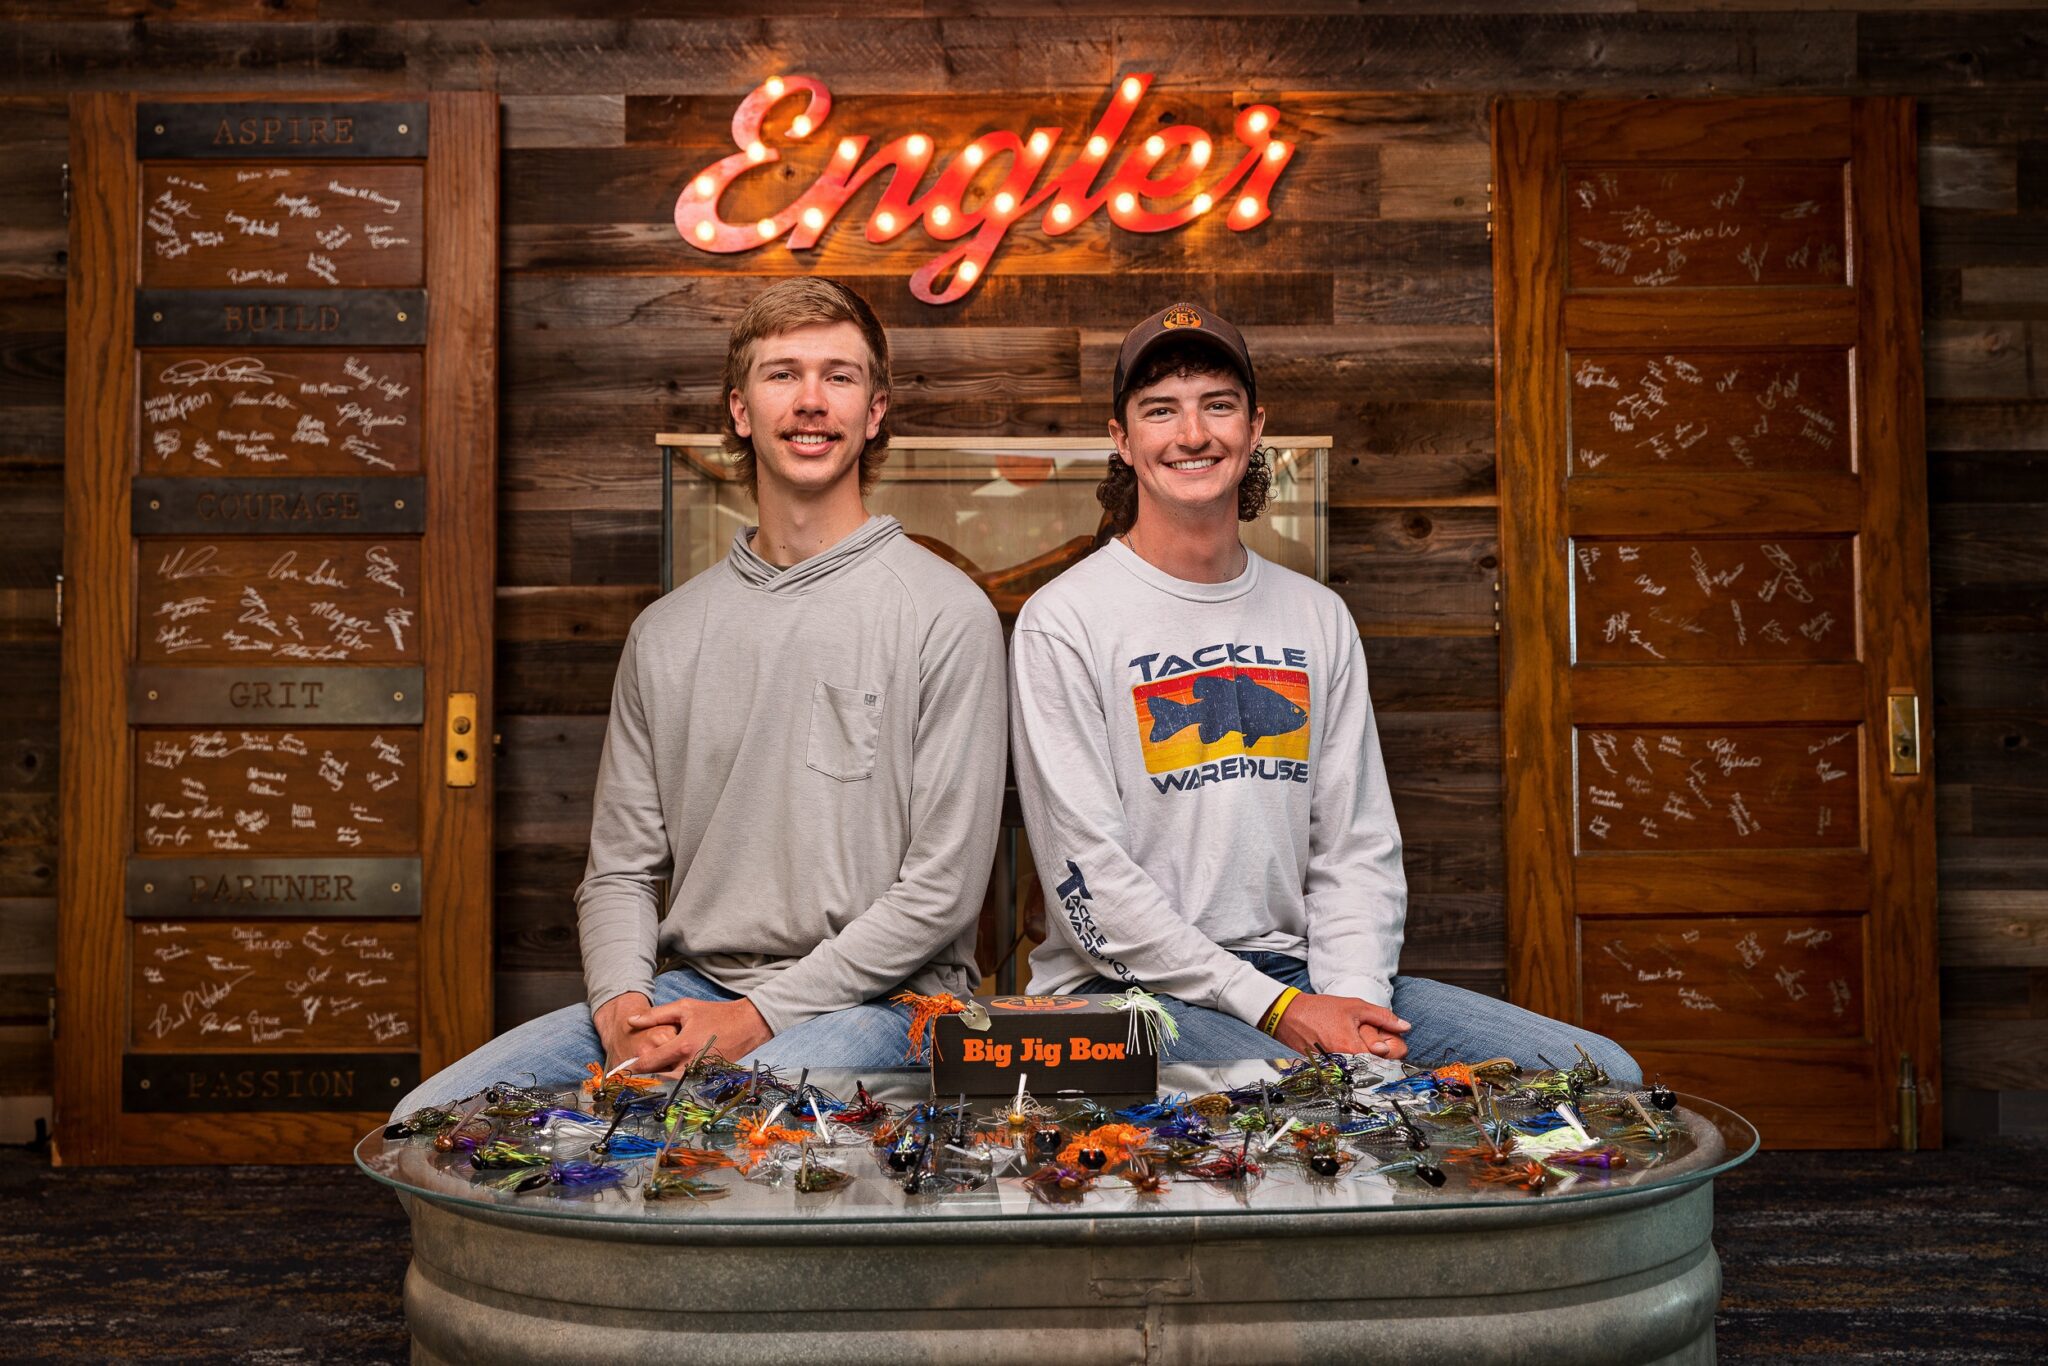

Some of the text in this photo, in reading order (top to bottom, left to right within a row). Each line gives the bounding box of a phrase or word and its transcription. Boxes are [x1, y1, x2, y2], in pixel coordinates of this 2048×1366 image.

[212, 116, 355, 146] ASPIRE
[674, 72, 1295, 304] Engler
[223, 304, 342, 333] BUILD
[196, 491, 361, 522] COURAGE
[1128, 642, 1308, 682] TACKLE
[229, 681, 324, 709] GRIT
[1151, 756, 1309, 795] WAREHOUSE
[188, 874, 357, 903] PARTNER
[1056, 859, 1108, 949] TACKLE
[1065, 897, 1141, 984] WAREHOU
[963, 1037, 1126, 1068] Big Jig Box
[186, 1070, 356, 1099] PASSION
